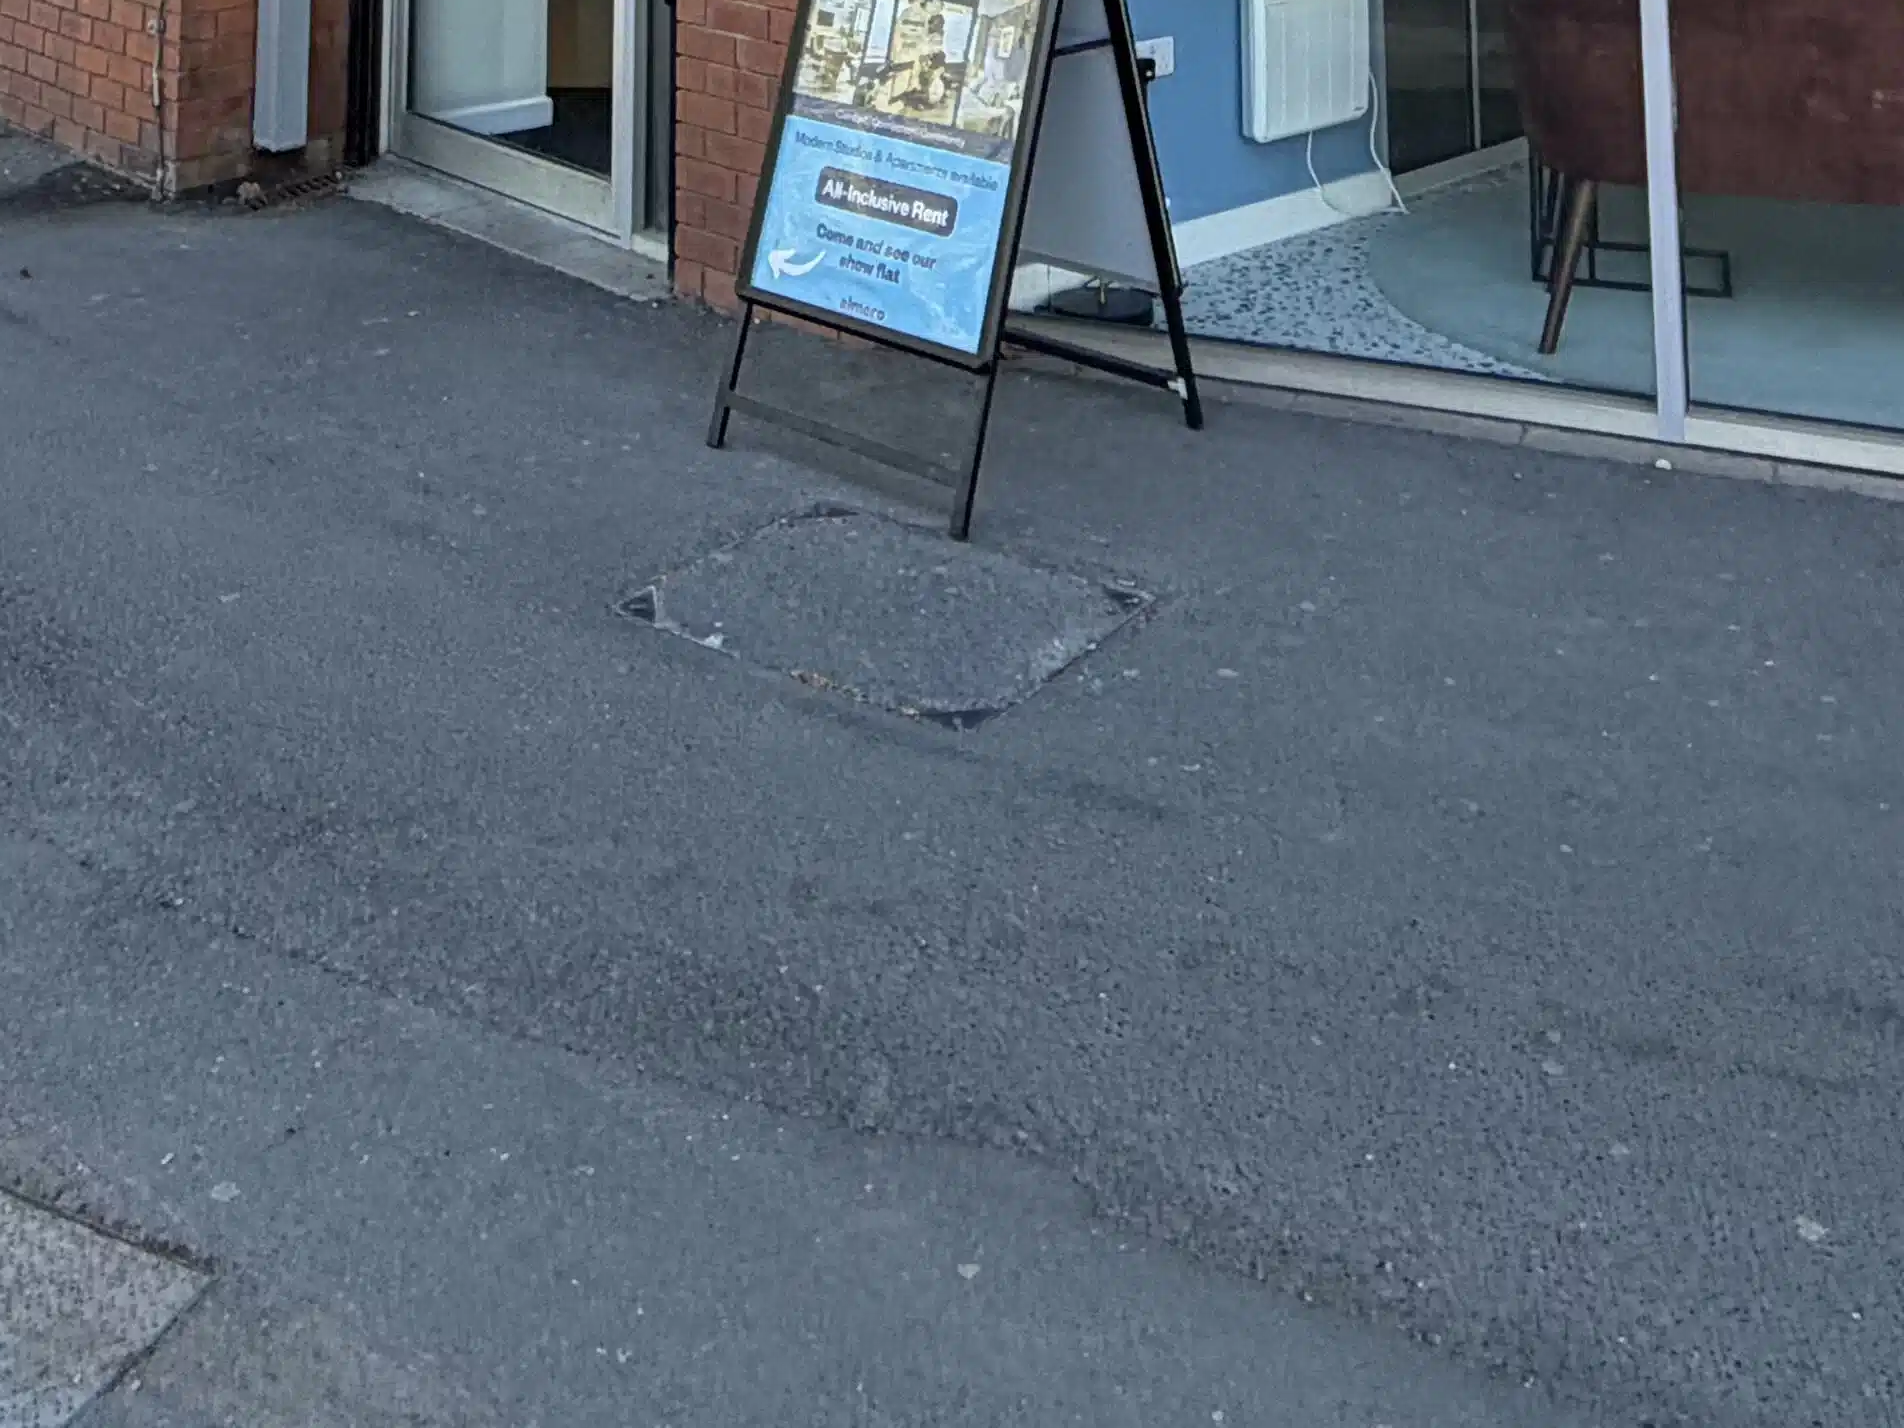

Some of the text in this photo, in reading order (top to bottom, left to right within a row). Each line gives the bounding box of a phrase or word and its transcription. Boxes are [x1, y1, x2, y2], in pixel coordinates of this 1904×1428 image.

[822, 179, 949, 227] All-Inclusive Rent
[816, 223, 938, 271] Come and see our
[839, 254, 901, 284] show flat
